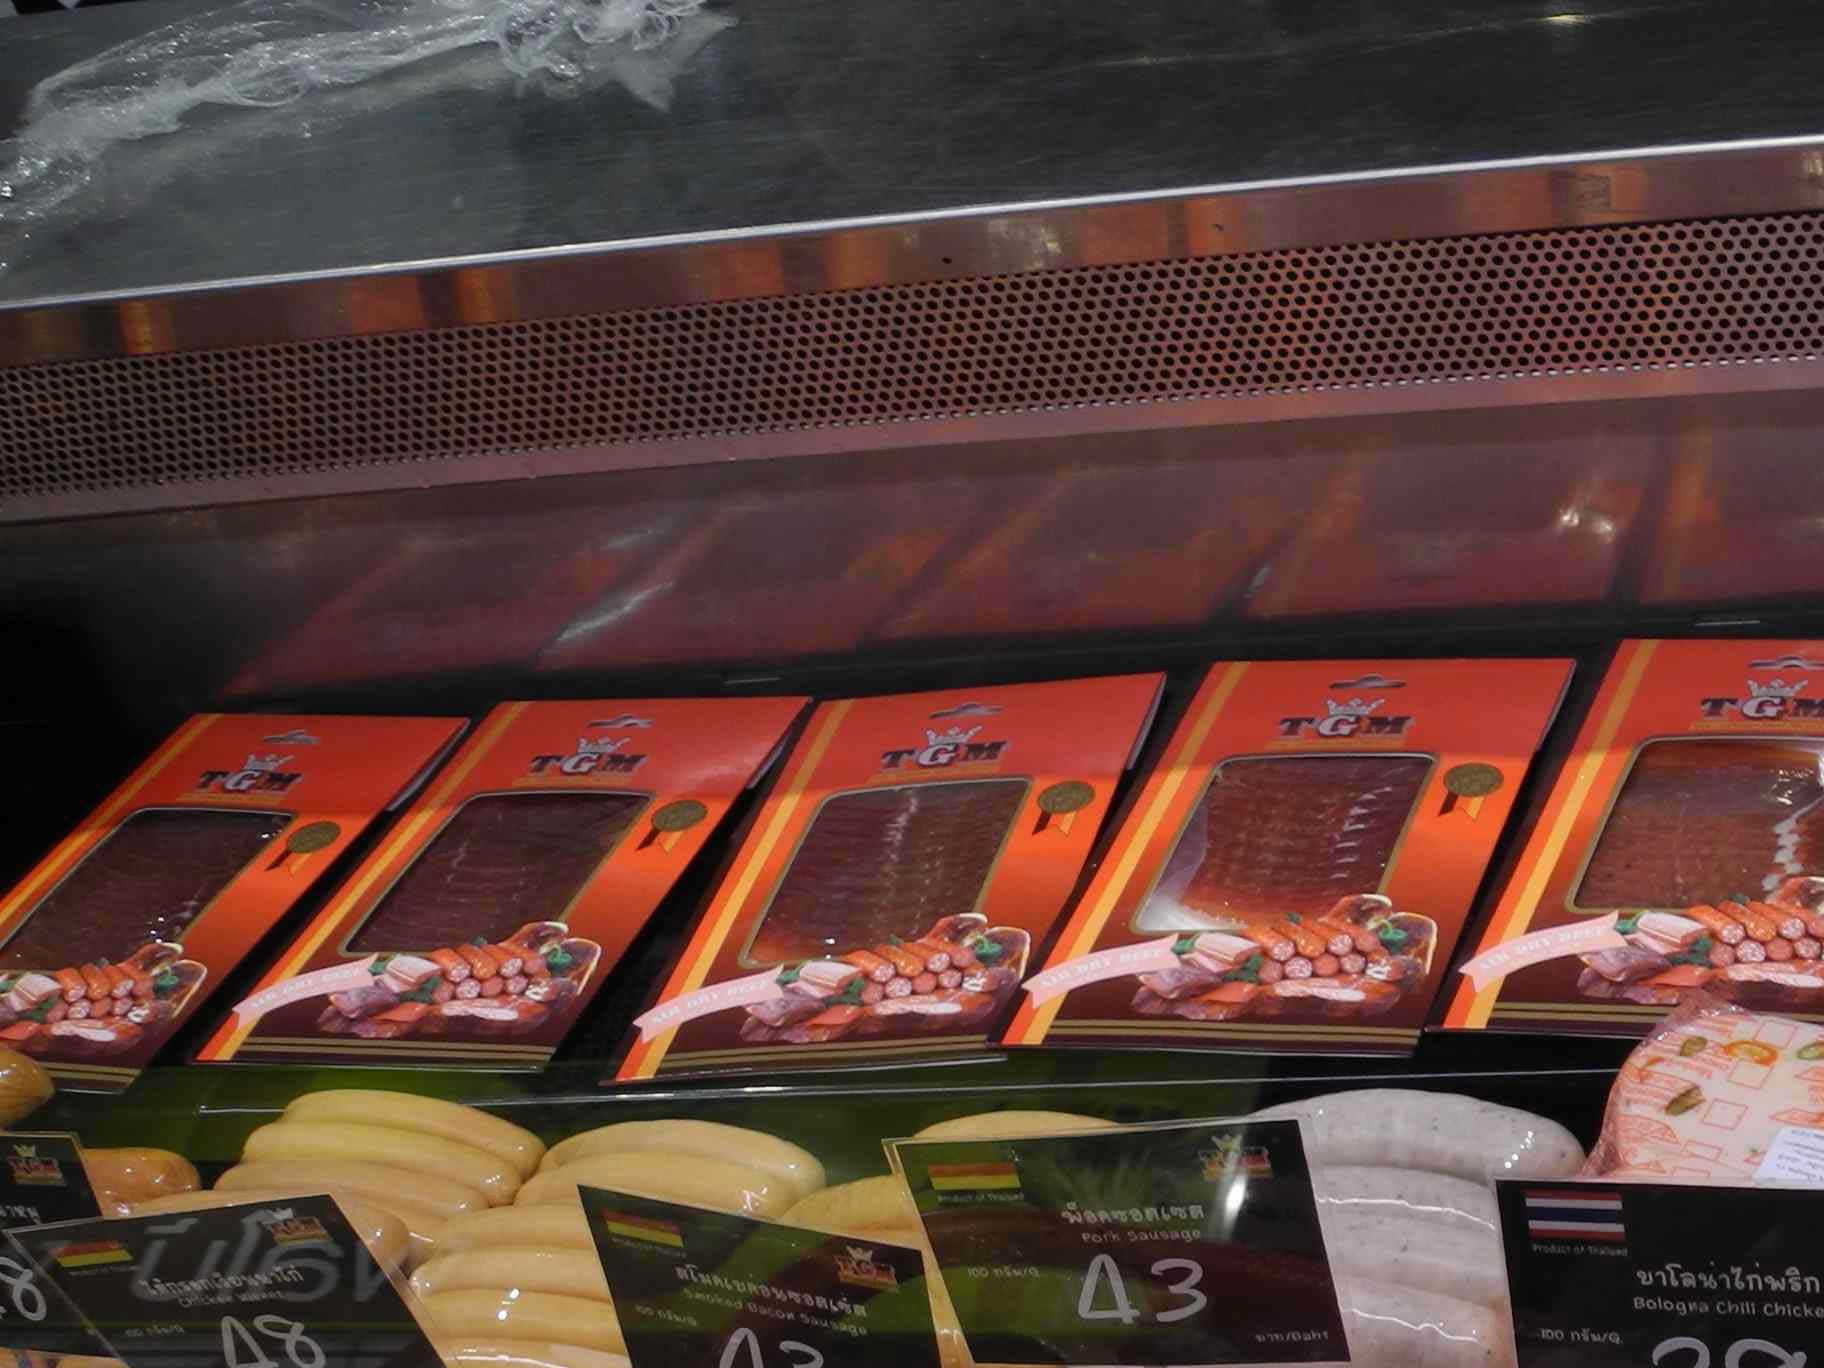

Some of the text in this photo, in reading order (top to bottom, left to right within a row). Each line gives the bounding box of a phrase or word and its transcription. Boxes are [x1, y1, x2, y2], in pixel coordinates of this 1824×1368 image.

[1278, 713, 1413, 739] TGM
[529, 751, 647, 776] TGM
[881, 738, 1011, 769] TGM
[199, 769, 303, 794] TGM
[0, 1256, 48, 1321] 8
[1078, 1254, 1207, 1324] 43
[1633, 1296, 1710, 1317] Bologna
[1716, 1299, 1756, 1316] Chili
